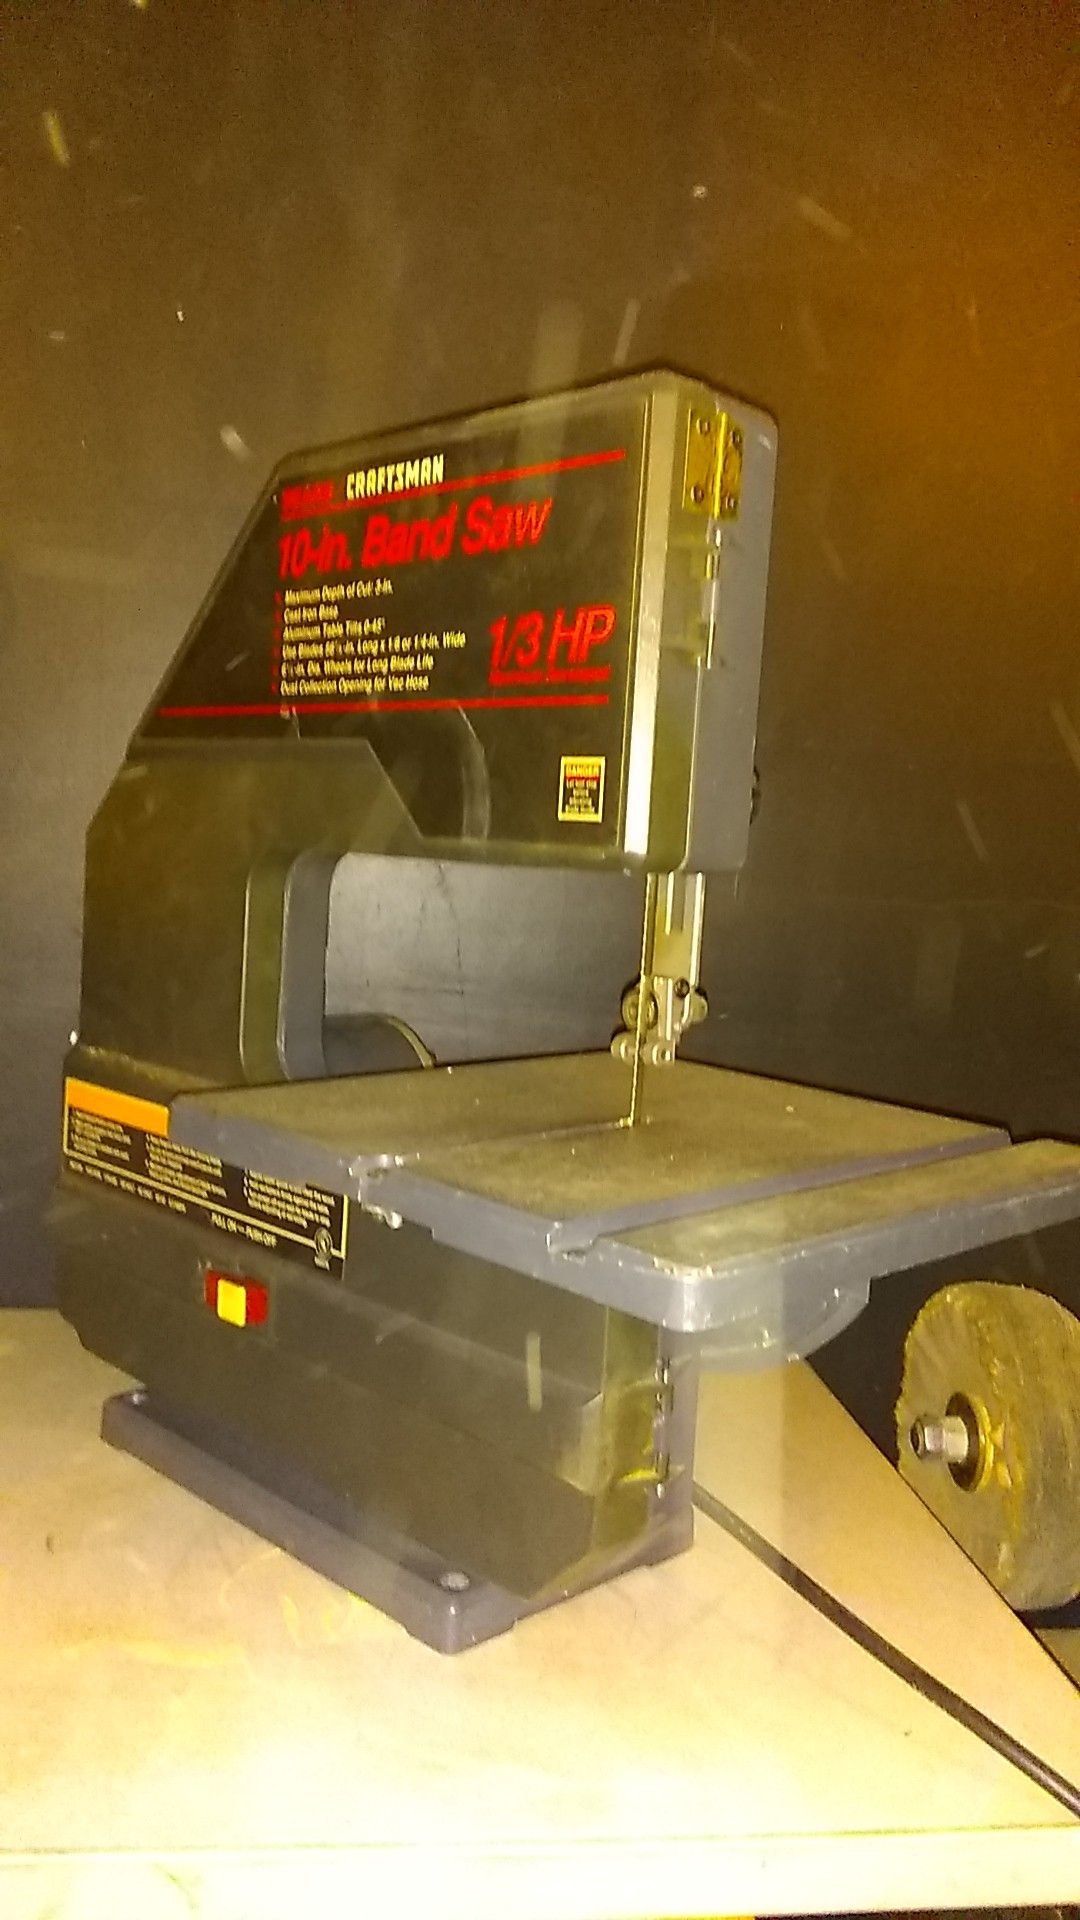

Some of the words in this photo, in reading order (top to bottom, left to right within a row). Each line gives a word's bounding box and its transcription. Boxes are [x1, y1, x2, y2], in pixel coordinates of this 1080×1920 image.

[346, 453, 444, 500] CRAFTSMAN
[279, 522, 352, 580] 10-in.
[361, 501, 458, 568] Band
[462, 495, 553, 556] Saw
[285, 588, 320, 606] Maximum
[322, 584, 344, 602] Depth
[346, 581, 356, 600] of
[284, 607, 301, 625] Cast
[302, 606, 317, 622] Iron
[319, 604, 339, 620] Base
[283, 624, 320, 641] Aluminum
[323, 621, 344, 639] Table
[346, 620, 362, 637] Tilts
[488, 611, 545, 670] 1/3
[548, 604, 616, 667] HP
[282, 643, 297, 660] Use
[298, 642, 324, 659] Blades
[357, 638, 378, 656] Long
[402, 636, 412, 652] or
[442, 630, 466, 649] Wide
[324, 659, 352, 676] Wheels
[354, 657, 366, 674] for
[367, 656, 388, 675] Long
[390, 654, 415, 672] Blade
[417, 653, 434, 671] Life
[300, 679, 337, 695] Collection
[339, 676, 372, 696] Opening
[374, 675, 386, 692] for
[388, 674, 404, 691] Vac
[405, 673, 429, 691] Hose
